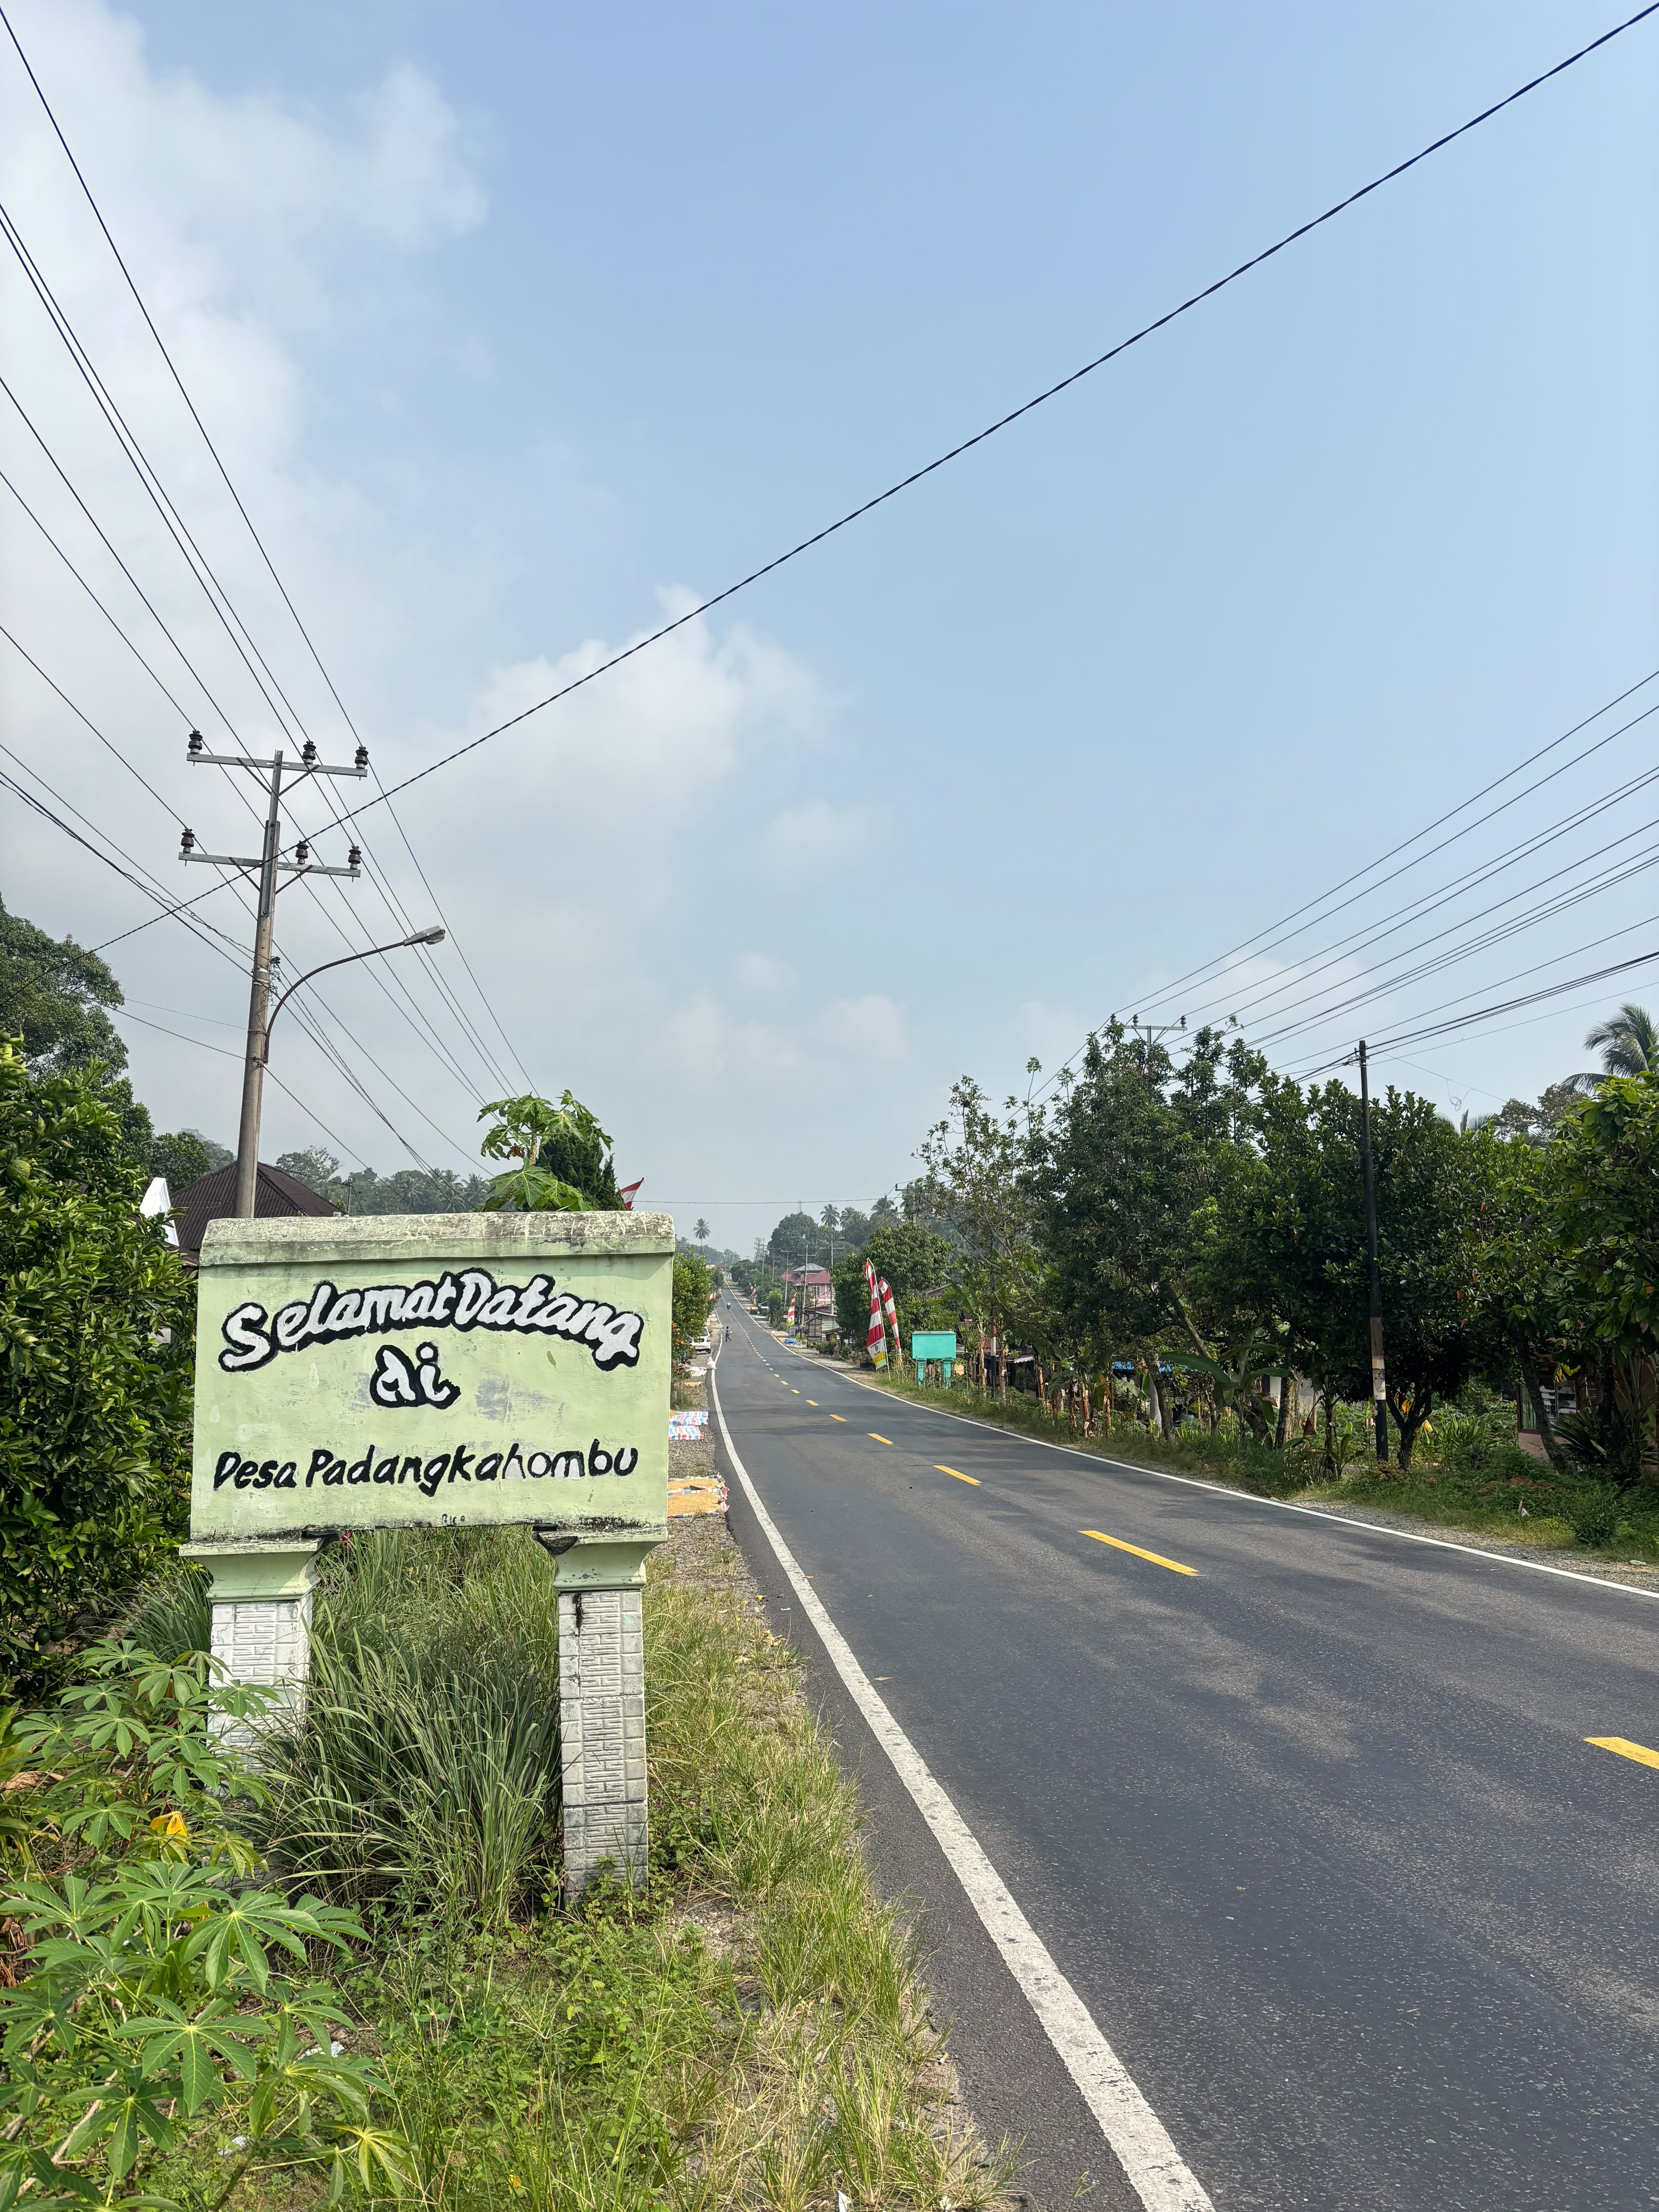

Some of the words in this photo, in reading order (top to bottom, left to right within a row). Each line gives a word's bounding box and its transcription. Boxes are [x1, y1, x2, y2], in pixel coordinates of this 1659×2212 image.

[219, 1271, 457, 1372] Selamat
[453, 1268, 644, 1371] Datang
[214, 1451, 297, 1490] Desa
